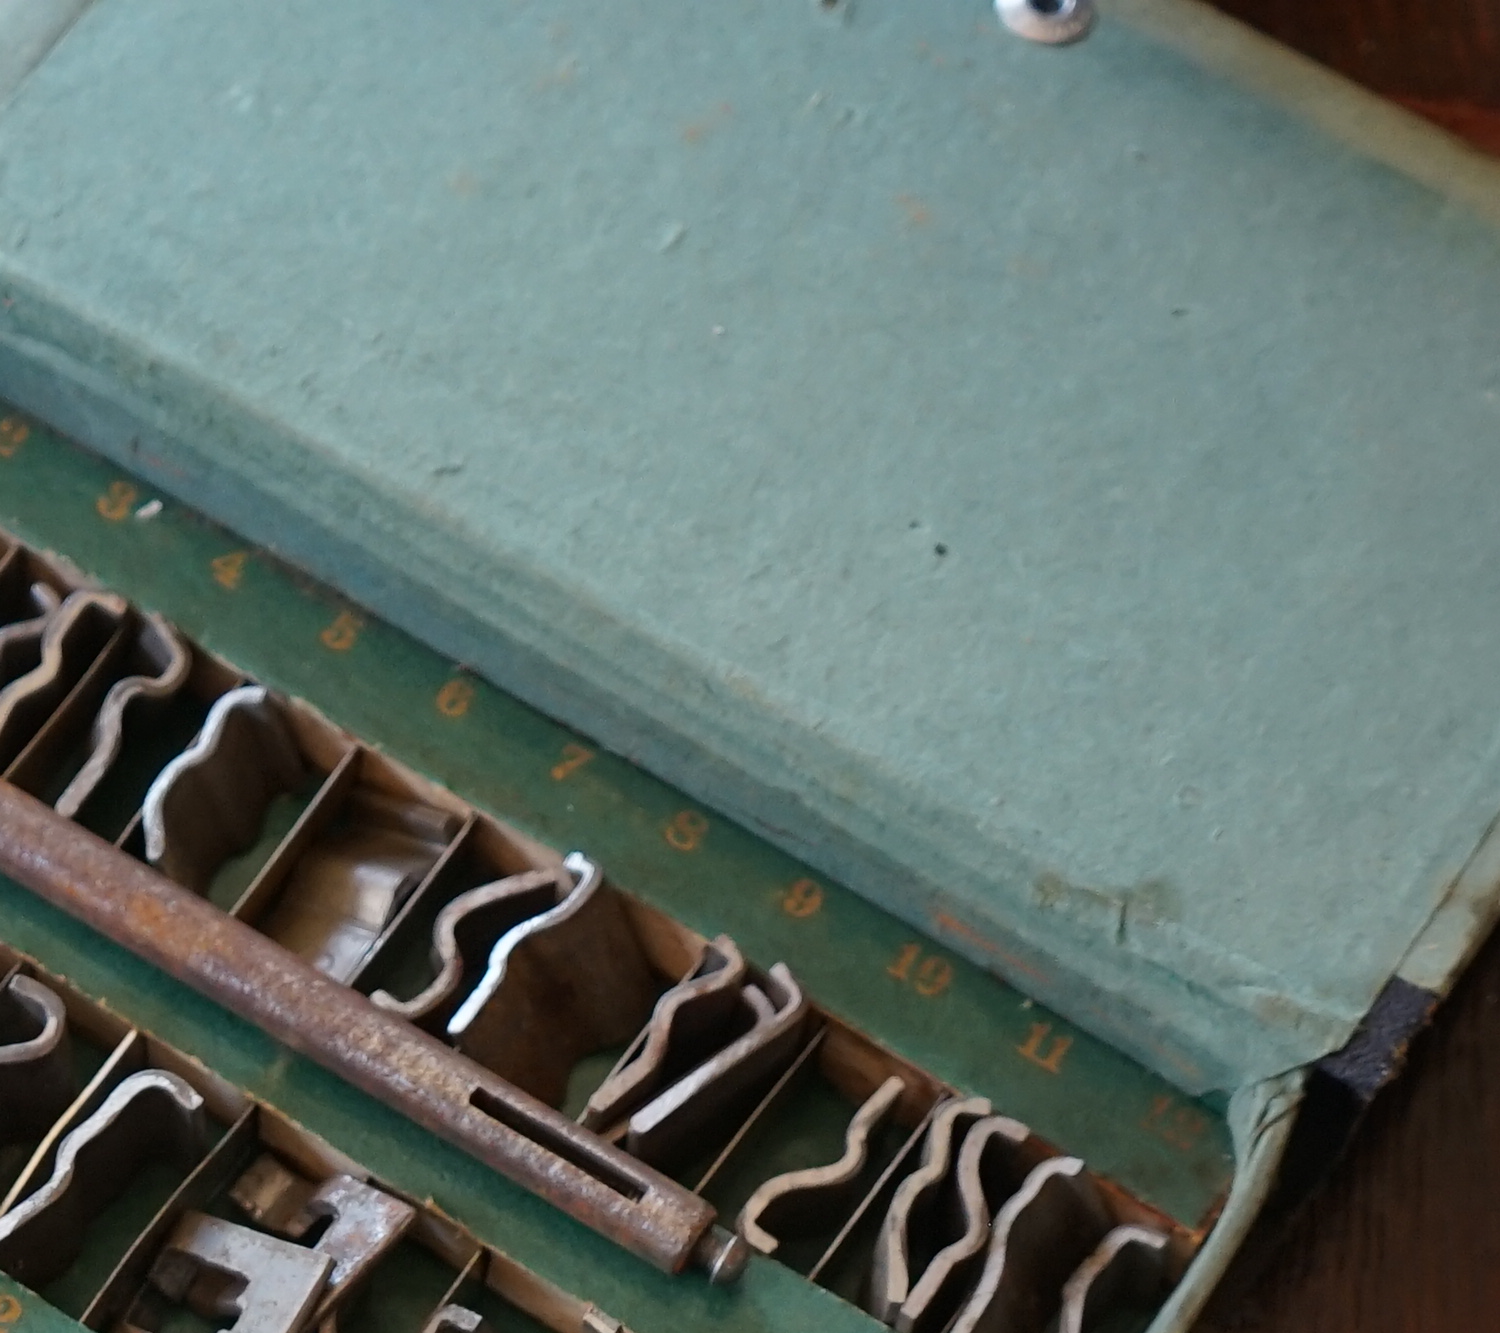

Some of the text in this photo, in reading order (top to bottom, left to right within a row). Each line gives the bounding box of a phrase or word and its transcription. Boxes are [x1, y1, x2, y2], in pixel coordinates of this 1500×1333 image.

[97, 484, 138, 517] 3
[210, 554, 249, 588] 4
[321, 612, 365, 652] 5
[436, 677, 474, 719] 6
[553, 743, 597, 781] 7
[666, 811, 707, 852] 8
[780, 880, 824, 918] 9
[887, 943, 953, 997] 10
[1016, 1022, 1074, 1074] 11
